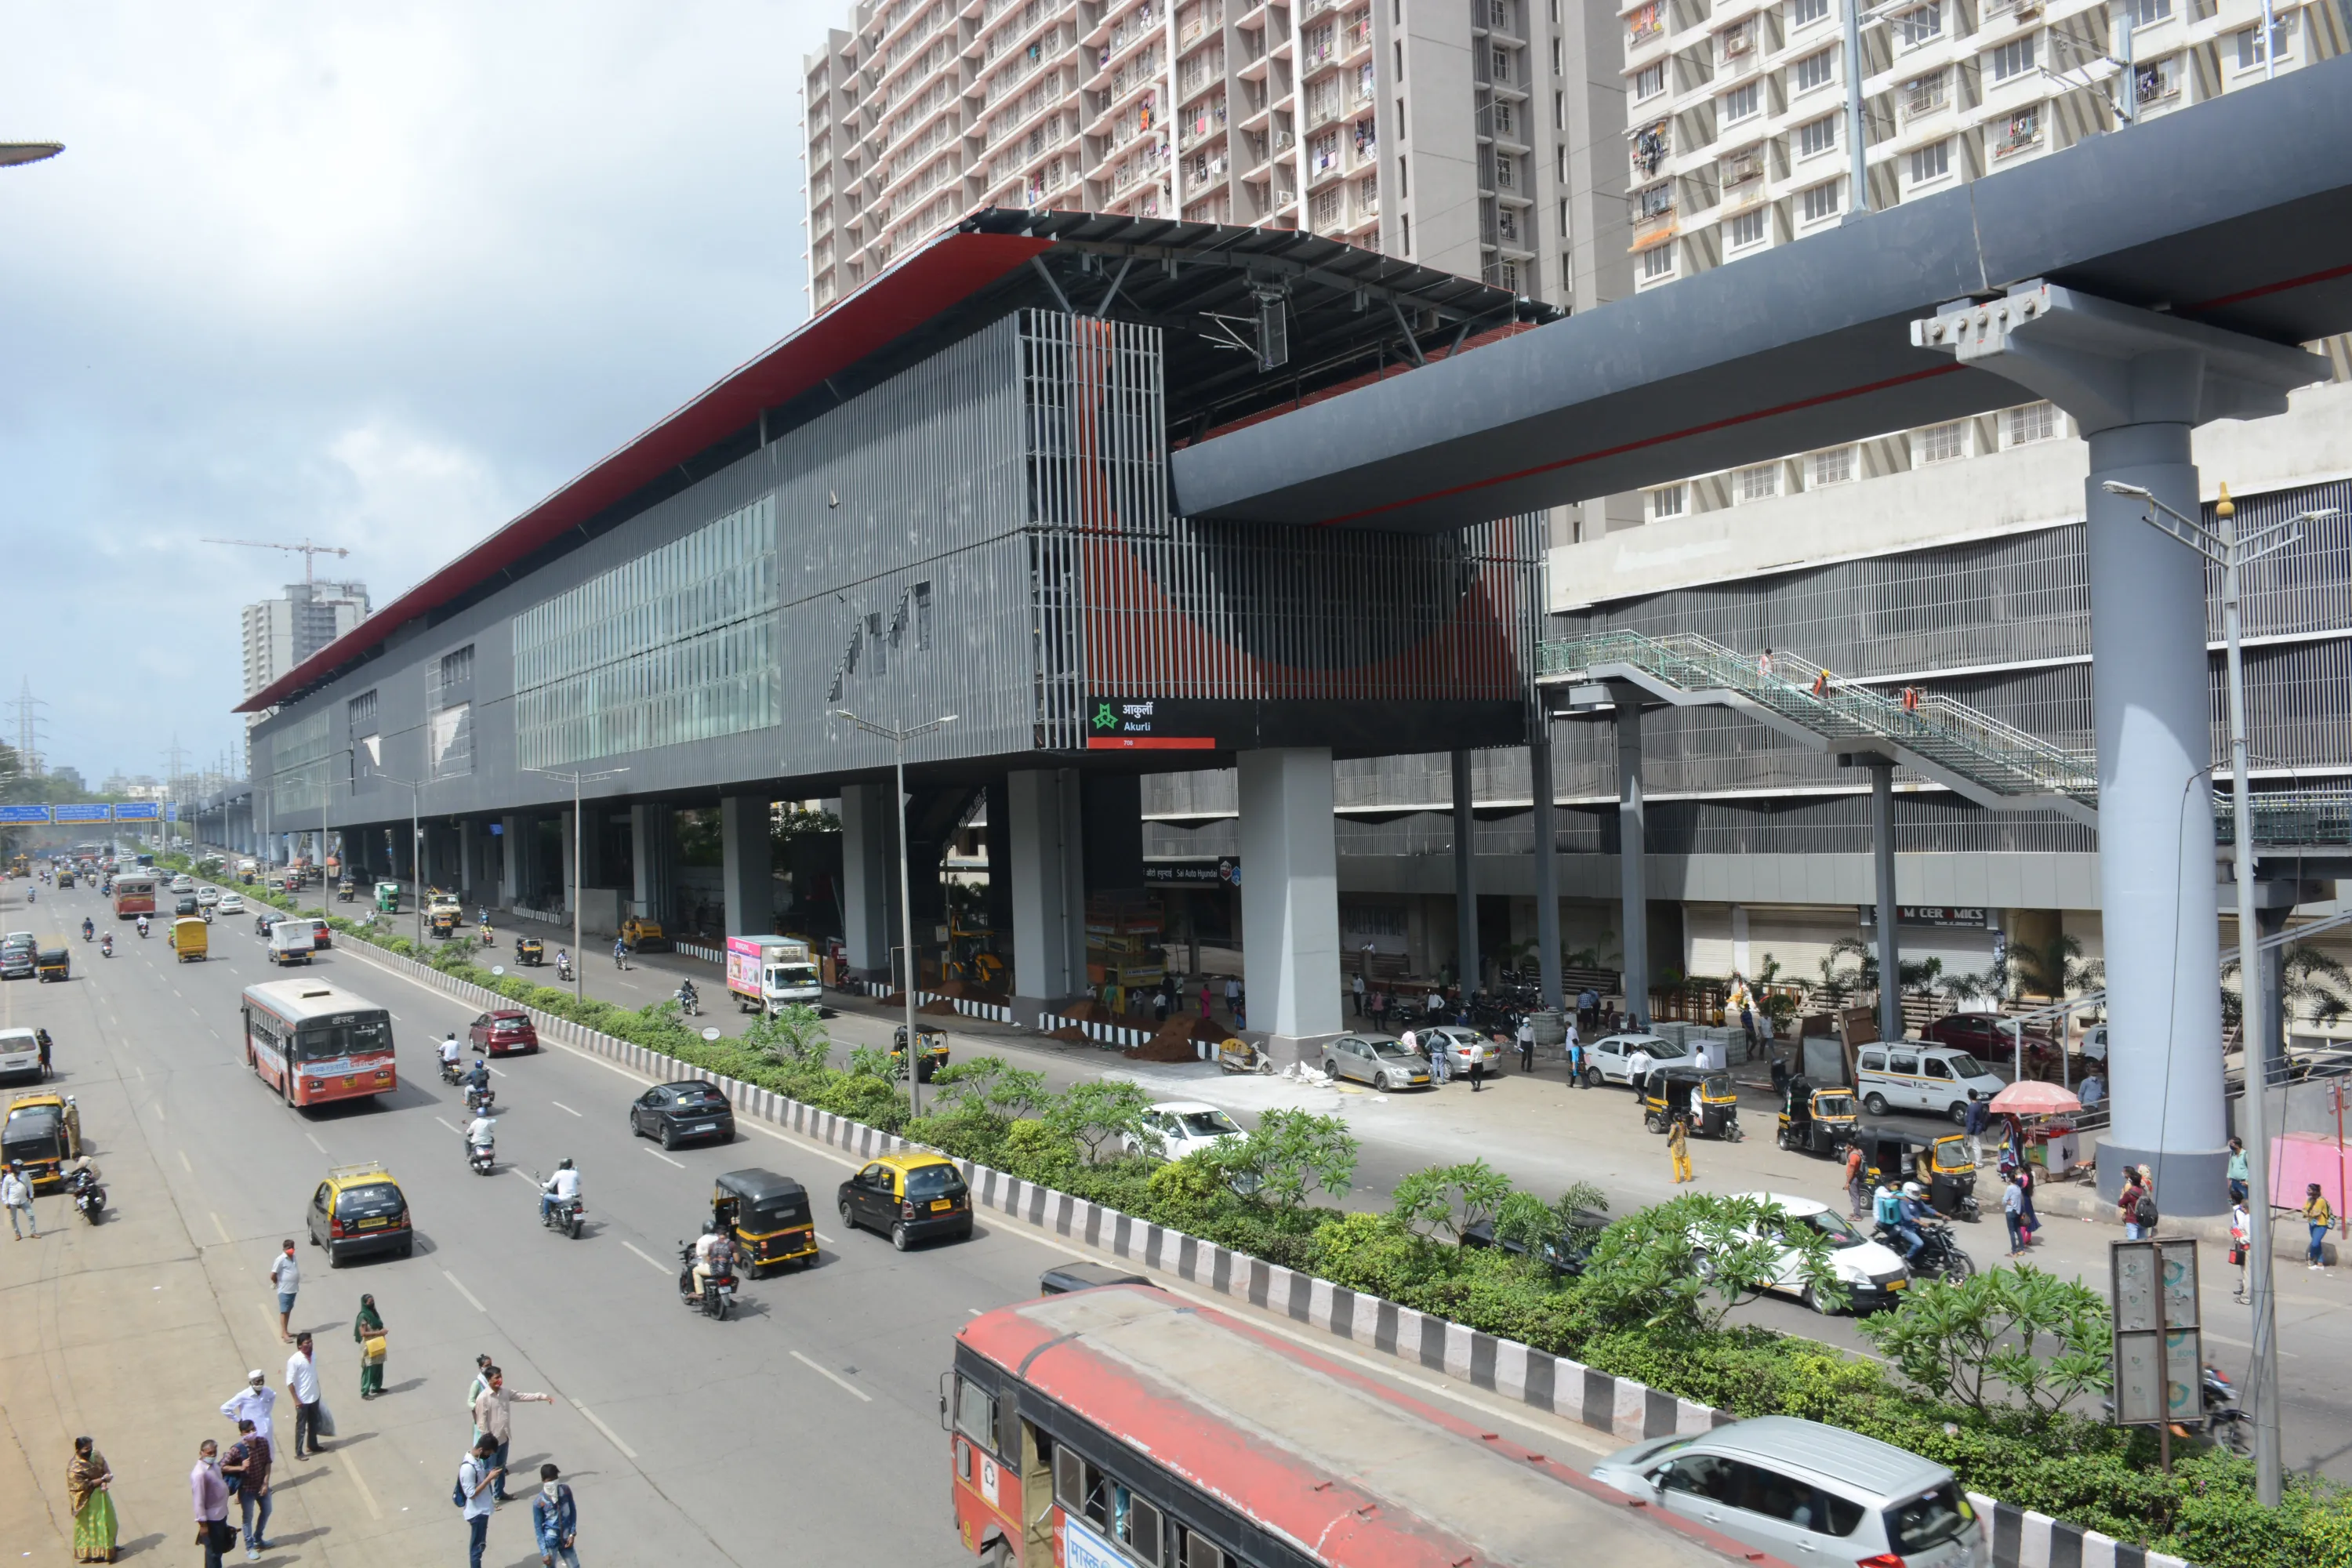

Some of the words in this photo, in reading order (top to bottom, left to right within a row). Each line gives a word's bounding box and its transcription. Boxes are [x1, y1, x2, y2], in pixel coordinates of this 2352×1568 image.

[1123, 702, 1153, 718] आकुर्ली
[1123, 721, 1151, 731] Akurli
[1197, 869, 1218, 880] Hyundai
